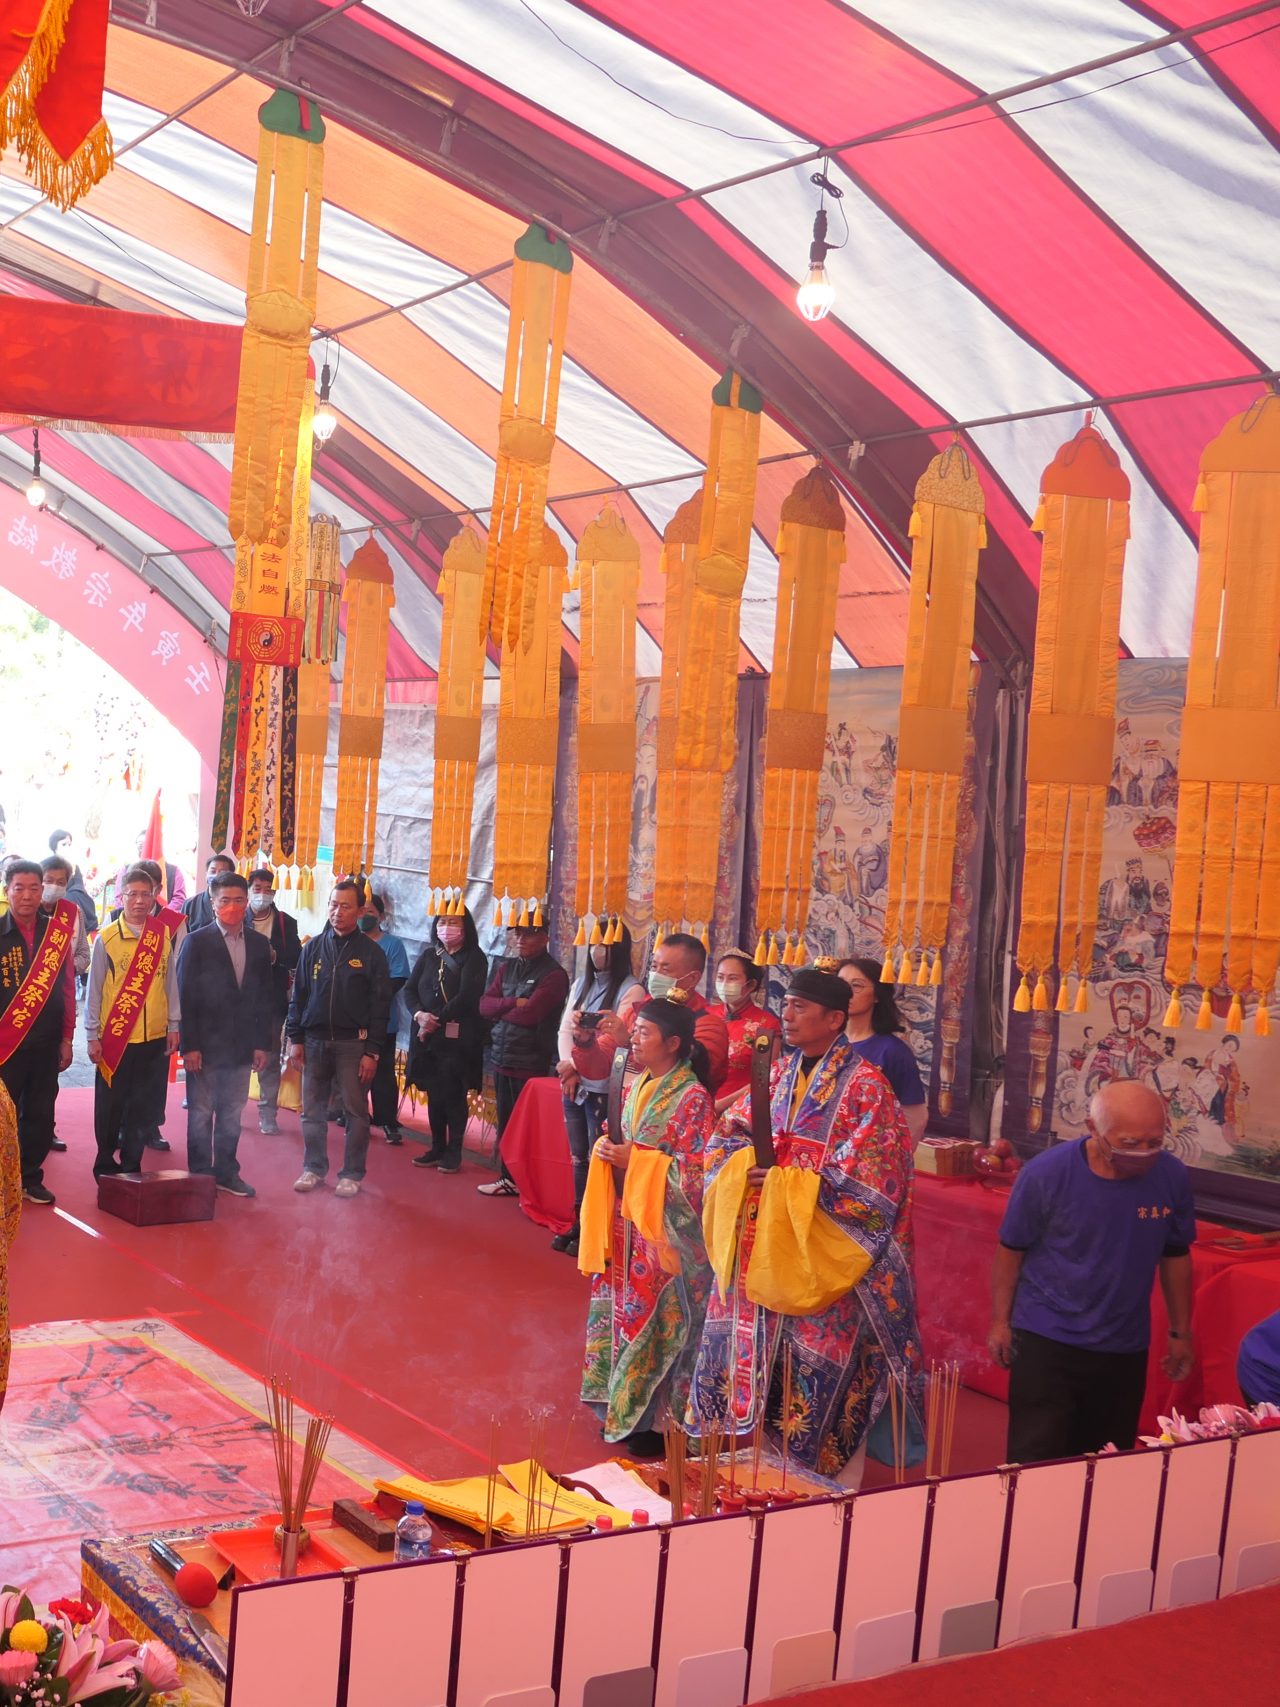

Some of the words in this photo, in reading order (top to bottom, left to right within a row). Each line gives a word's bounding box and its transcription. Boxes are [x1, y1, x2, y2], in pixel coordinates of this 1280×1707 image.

[12, 928, 68, 1028] 副總主祭官
[110, 930, 160, 1036] 副總主祭官
